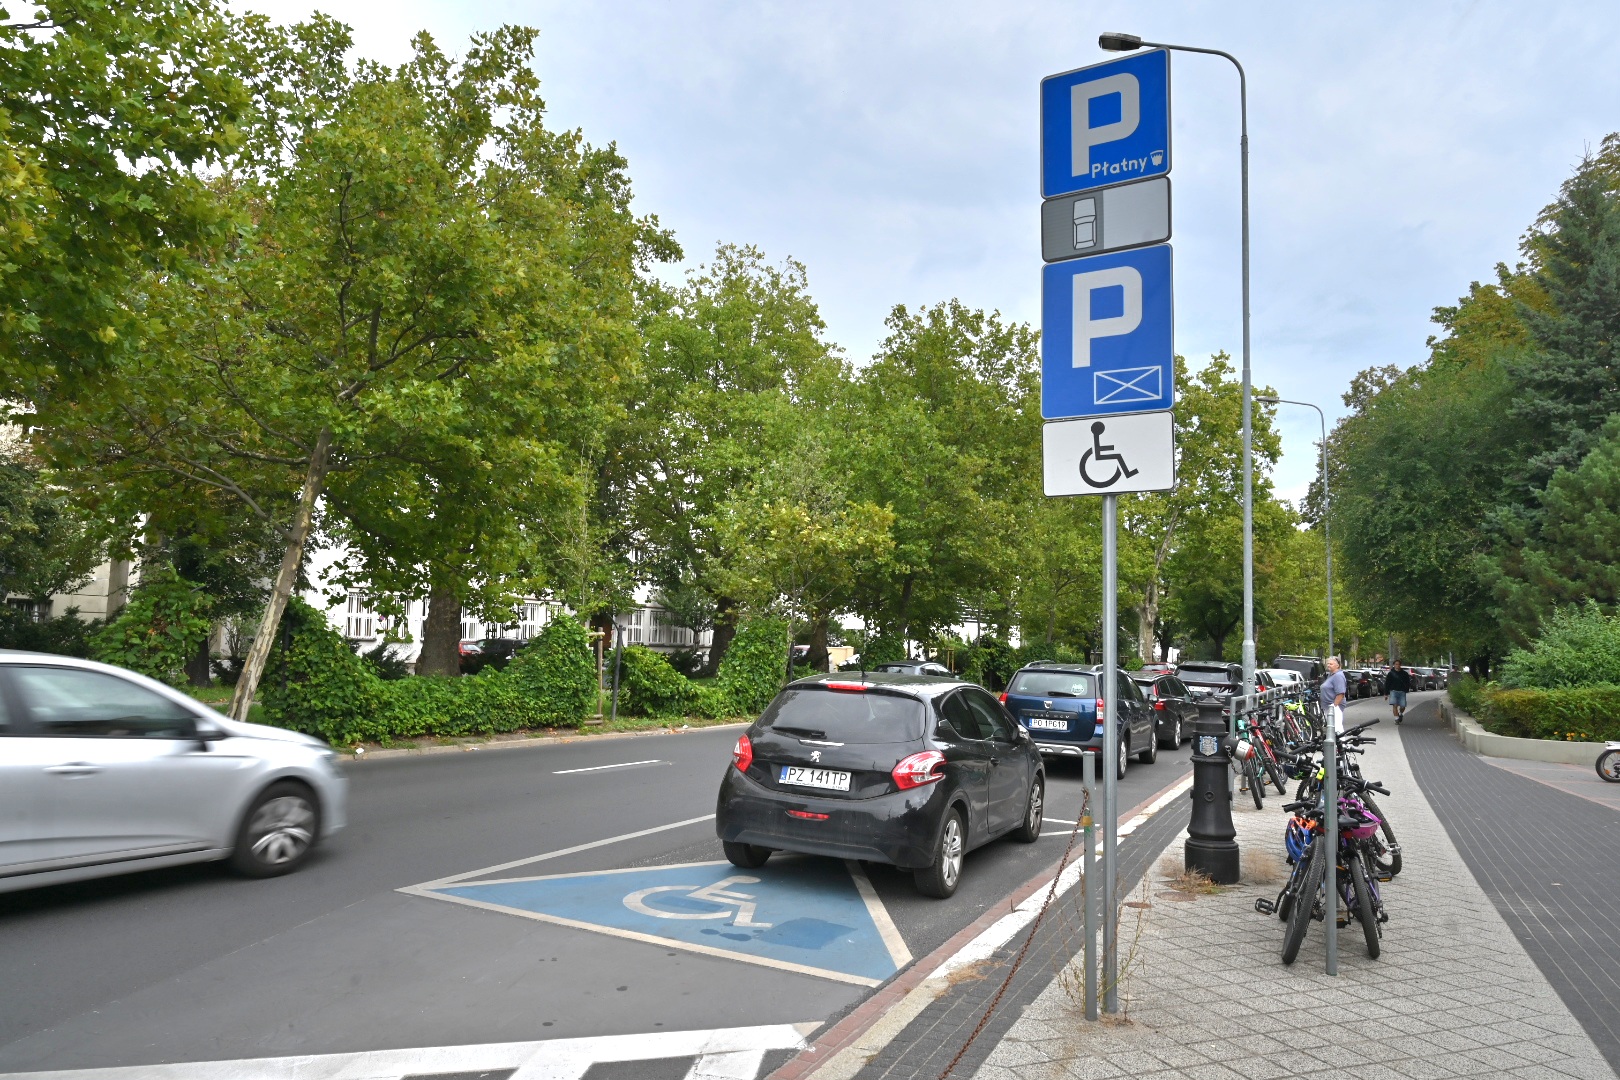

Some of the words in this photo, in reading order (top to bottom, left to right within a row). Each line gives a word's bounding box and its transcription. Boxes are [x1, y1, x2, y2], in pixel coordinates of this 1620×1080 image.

[1071, 72, 1140, 177] P
[1092, 157, 1147, 178] Płatny
[1072, 265, 1142, 368] P
[788, 768, 805, 781] PZ
[810, 769, 848, 785] 141TP
